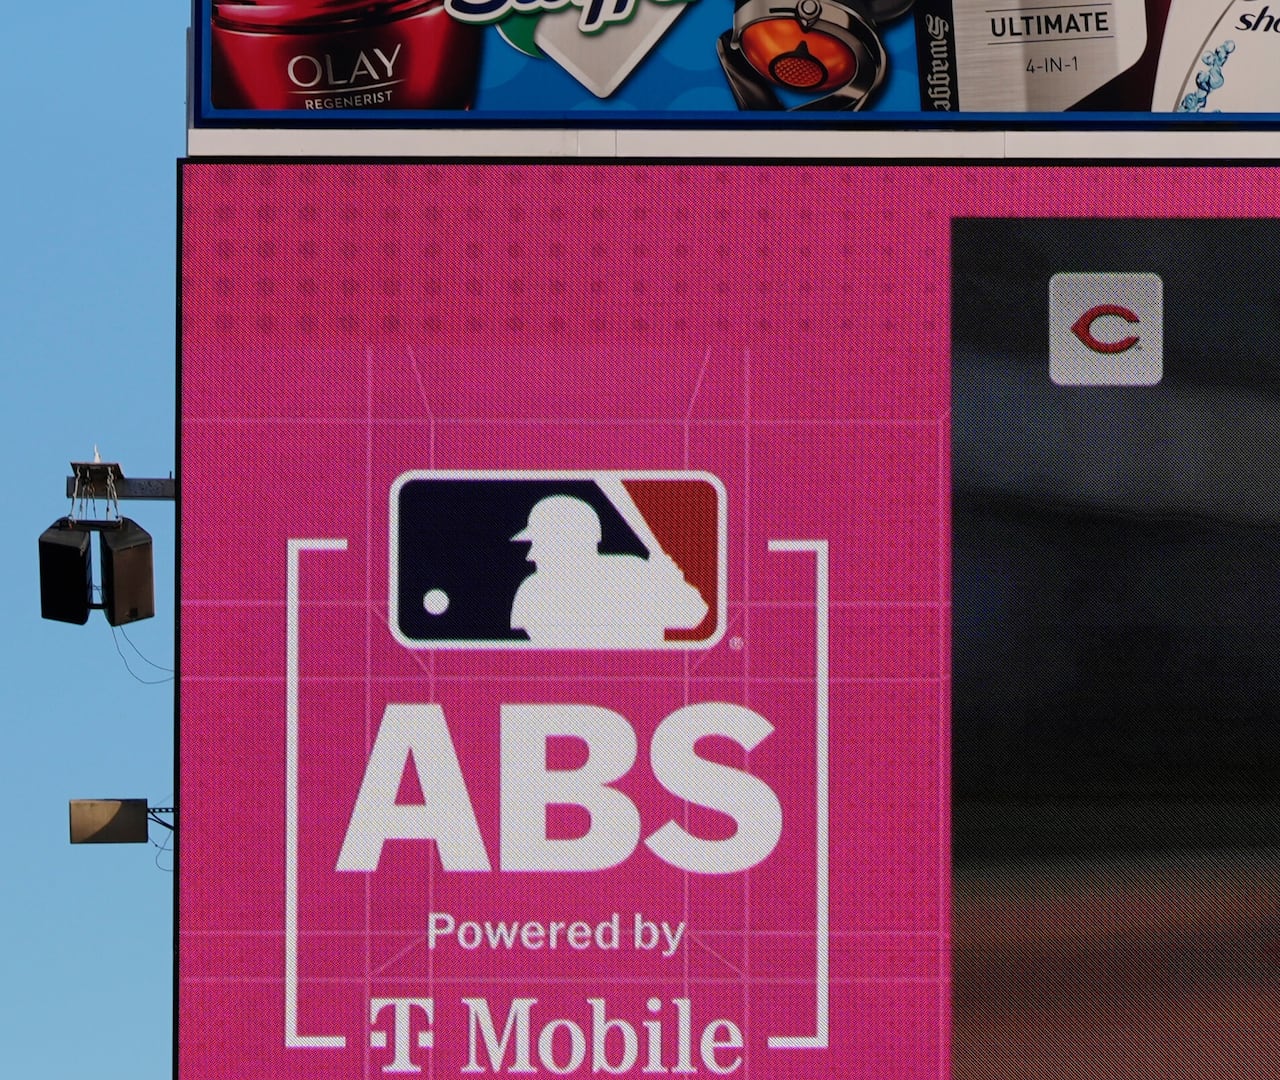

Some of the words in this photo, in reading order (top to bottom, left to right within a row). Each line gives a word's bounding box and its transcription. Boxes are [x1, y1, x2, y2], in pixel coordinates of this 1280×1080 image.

[991, 12, 1109, 37] ULTIMATE
[288, 43, 401, 88] OLAY
[1026, 56, 1079, 74] 4-IN-1
[305, 90, 393, 110] REGENERIST
[1071, 304, 1140, 354] C
[335, 701, 783, 875] ABS
[427, 912, 621, 950] Powered
[633, 912, 687, 956] by
[461, 997, 744, 1075] Mobile
